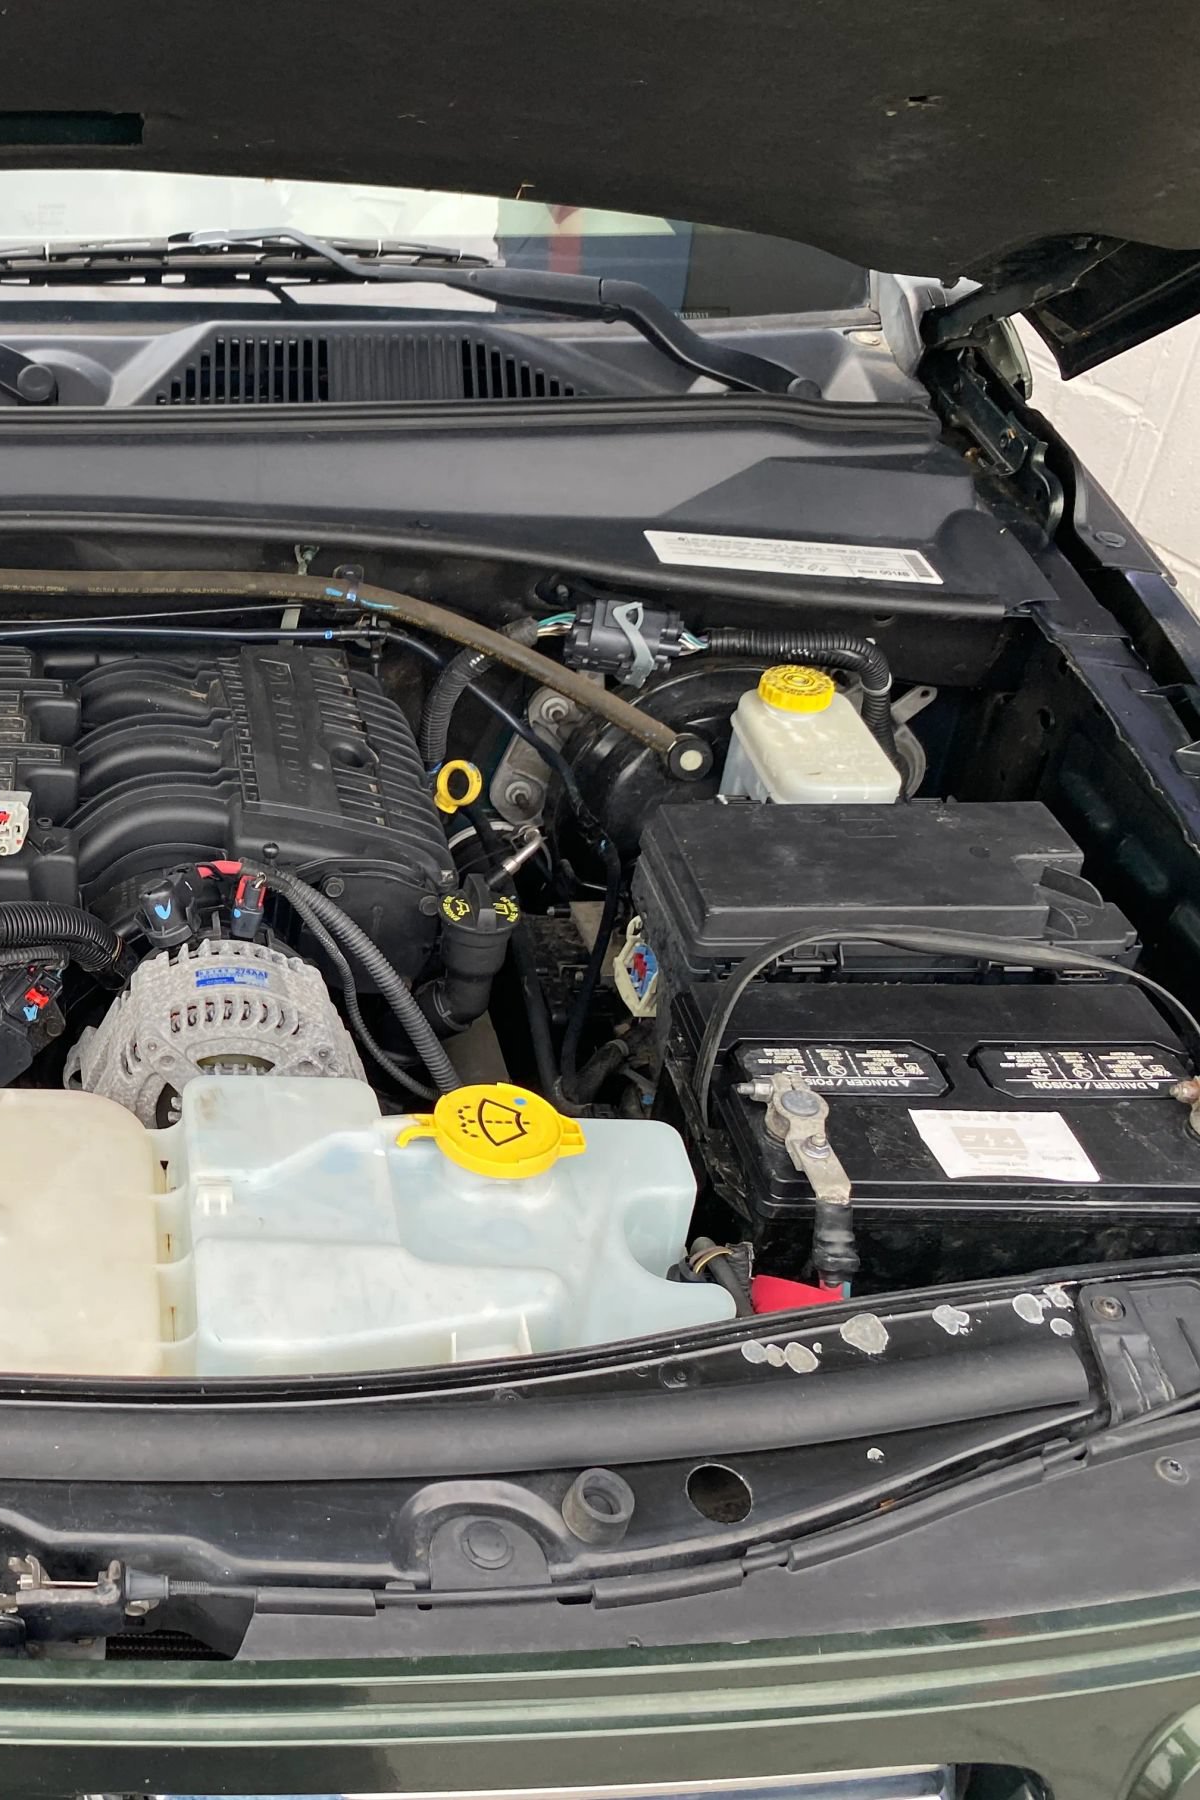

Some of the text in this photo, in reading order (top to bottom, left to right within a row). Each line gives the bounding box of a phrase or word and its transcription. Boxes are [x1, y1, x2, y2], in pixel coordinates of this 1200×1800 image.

[805, 1077, 833, 1087] POIS
[847, 1078, 899, 1088] DANGER
[1034, 1080, 1082, 1090] POISON
[1093, 1080, 1148, 1090] DANGER
